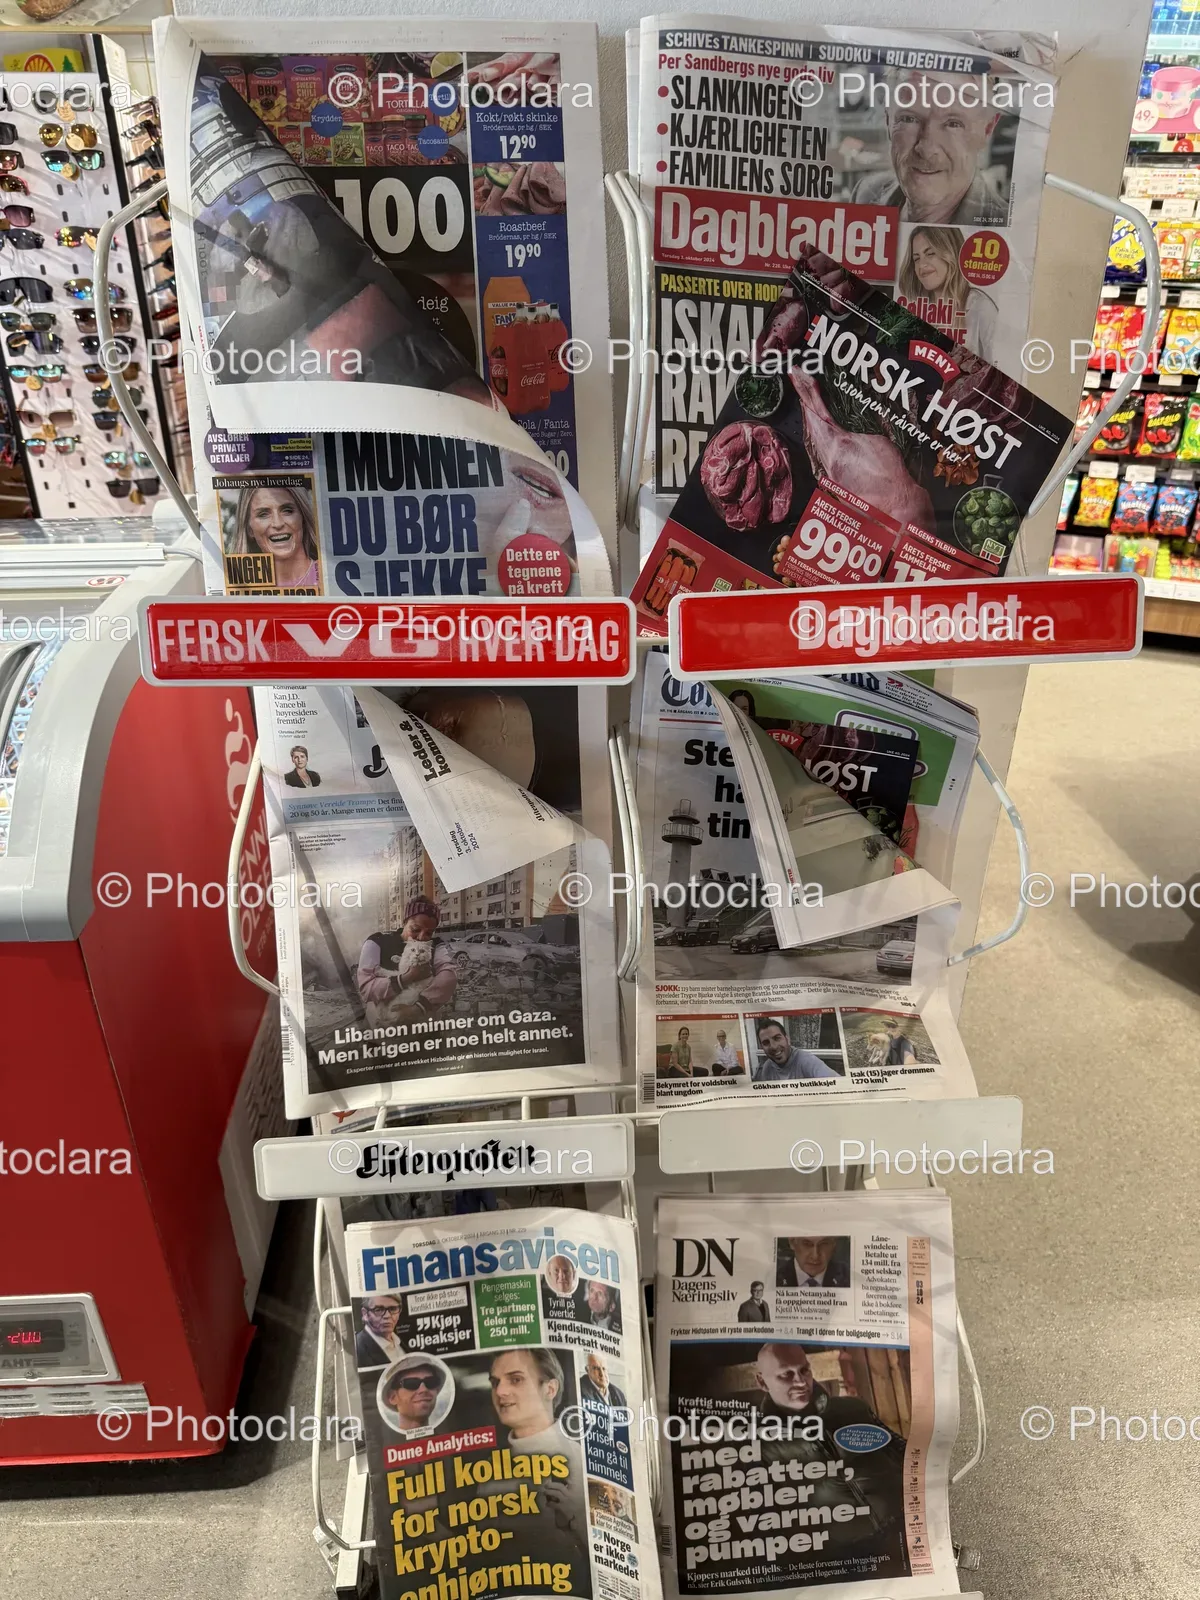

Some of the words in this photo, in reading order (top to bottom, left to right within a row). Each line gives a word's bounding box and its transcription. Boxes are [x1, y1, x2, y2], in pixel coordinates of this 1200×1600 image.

[666, 33, 720, 49] SCHIVEs
[721, 35, 804, 59] TANKESPINN
[818, 44, 872, 63] SUDOKU
[886, 50, 974, 72] BILDEGITTER
[658, 54, 681, 69] Per
[685, 54, 755, 78] Sandbergs
[758, 63, 780, 80] nye
[818, 66, 835, 84] liv
[257, 85, 278, 97] BBQ
[671, 75, 804, 121] SLANKINGEN
[311, 114, 342, 124] Krydder
[526, 112, 559, 123] skinke
[418, 138, 449, 146] Tacosaus
[670, 113, 828, 161] KJÆRLIGHETEN
[670, 150, 775, 194] FAMILIENs
[780, 161, 834, 199] SORG
[335, 176, 466, 254] 100
[499, 221, 547, 232] Roastbeef
[660, 191, 891, 267] Dagbladet
[971, 237, 1000, 260] 10
[964, 259, 1003, 272] stønader
[661, 273, 720, 297] PASSERTE
[722, 280, 753, 300] OVER
[914, 345, 955, 375] MENY
[807, 314, 925, 411] NORSK
[922, 389, 1022, 470] HØST
[544, 418, 570, 430] Fanta
[834, 372, 892, 418] Sesongens
[889, 412, 931, 444] råvarer
[941, 443, 971, 464] her!
[207, 434, 250, 443] AVSLØRER
[212, 443, 246, 453] PRIVATE
[210, 453, 250, 464] DETALJER
[324, 432, 339, 492] I
[342, 432, 504, 492] MUNNEN
[214, 478, 250, 489] Johaugs
[250, 478, 266, 489] nye
[267, 476, 303, 488] hverdag:
[820, 478, 850, 500] HELGENS
[847, 494, 870, 512] TILBUD
[328, 496, 387, 556] DU
[394, 493, 479, 555] BØR
[814, 497, 837, 518] ÅRETS
[835, 510, 862, 531] FERSKE
[907, 524, 936, 546] HELGENS
[934, 539, 957, 556] TILBUD
[506, 548, 542, 562] Dette
[545, 548, 561, 561] er
[899, 550, 938, 574] LAMMELÅR
[903, 543, 926, 562] ÅRETS
[923, 555, 952, 571] FERSKE
[226, 555, 273, 585] INGEN
[507, 564, 561, 581] tegnene
[508, 582, 525, 597] på
[526, 580, 563, 595] kreft
[800, 592, 1022, 657] Dagbladet
[158, 618, 270, 663] FERSK
[281, 622, 439, 659] VG
[459, 619, 546, 663] HVER
[555, 618, 620, 662] DAG
[275, 708, 318, 717] høyresidens
[276, 717, 306, 725] fremtid?
[408, 733, 438, 782] Leder
[454, 822, 469, 848] oktober
[467, 833, 480, 851] 2024
[334, 1023, 409, 1045] Libanon
[411, 1017, 474, 1035] minner
[477, 1014, 506, 1029] om
[508, 1009, 557, 1026] Gaza.
[318, 1048, 359, 1066] Men
[362, 1041, 421, 1061] krigen
[423, 1038, 443, 1051] er
[446, 1034, 479, 1048] noe
[482, 1029, 516, 1045] helt
[518, 1025, 574, 1042] annet.
[656, 1080, 689, 1089] Bekymret
[701, 1079, 738, 1087] voldsbruk
[799, 1080, 837, 1088] butikksjef
[899, 1067, 936, 1076] drømmen
[656, 1089, 673, 1097] blant
[674, 1088, 703, 1097] ungdom
[361, 1226, 621, 1293] Finansavisen
[672, 1237, 740, 1278] DN
[876, 1268, 902, 1276] selskap
[481, 1279, 531, 1294] Pengemaskin
[672, 1279, 717, 1292] Dagens
[672, 1289, 738, 1304] Næringsliv
[799, 1290, 837, 1298] Netanyahu
[483, 1316, 507, 1326] deler
[509, 1313, 535, 1324] rundt
[497, 1303, 536, 1316] partnere
[549, 1309, 576, 1319] overtid:
[408, 1329, 472, 1350] oljeaksjer
[489, 1326, 509, 1338] 250
[547, 1320, 620, 1346] Kjendisinvestorer
[564, 1335, 598, 1349] fortsatt
[599, 1342, 621, 1358] vente
[678, 1396, 713, 1409] Kraftig
[715, 1398, 751, 1409] nedtur
[387, 1444, 423, 1464] Dune
[426, 1432, 495, 1457] Analytics:
[681, 1440, 762, 1471] med
[387, 1461, 446, 1504] Full
[453, 1449, 570, 1489] kollaps
[588, 1458, 628, 1484] himmels
[682, 1459, 855, 1494] rabatter,
[391, 1506, 443, 1542] for
[448, 1484, 540, 1527] norsk
[683, 1484, 815, 1519] møbler
[684, 1514, 733, 1545] og
[736, 1502, 871, 1534] varme-
[394, 1525, 514, 1577] krypto-
[605, 1545, 626, 1562] ikke
[686, 1529, 830, 1570] pumper
[594, 1554, 640, 1581] markedet
[687, 1571, 720, 1582] Kjøpers
[720, 1568, 751, 1578] marked
